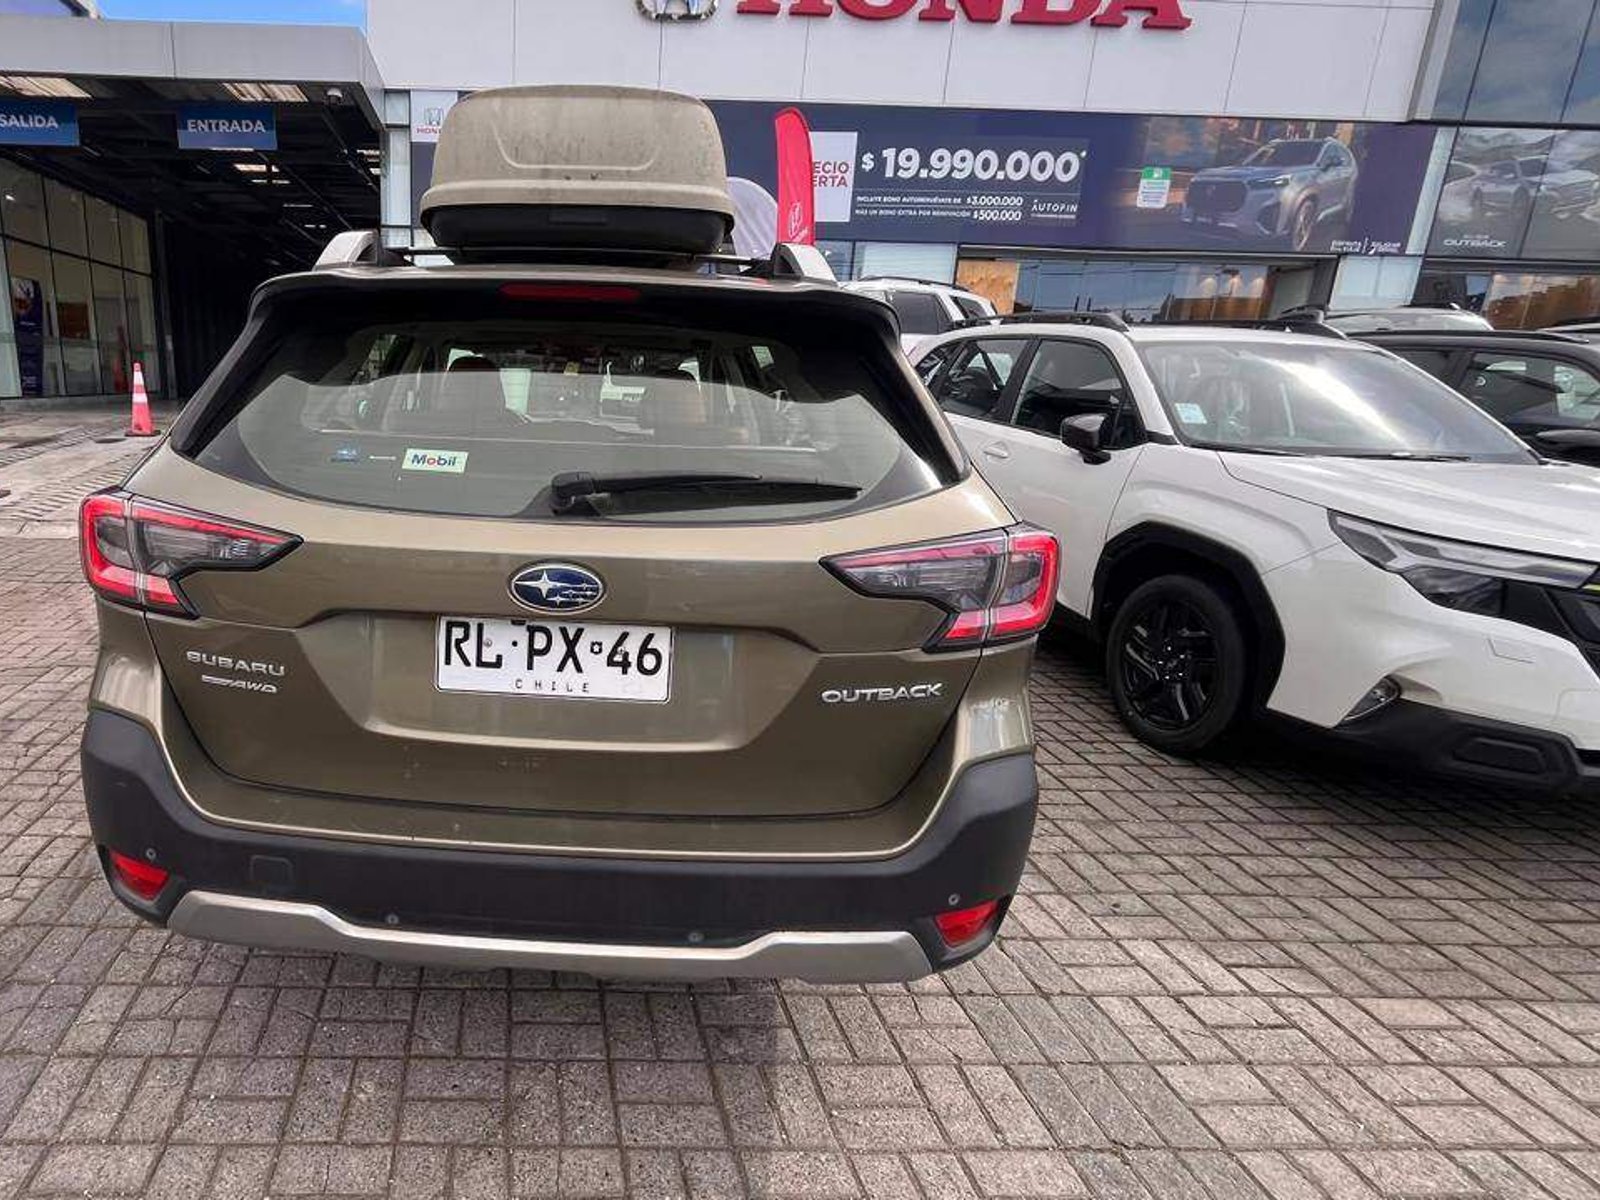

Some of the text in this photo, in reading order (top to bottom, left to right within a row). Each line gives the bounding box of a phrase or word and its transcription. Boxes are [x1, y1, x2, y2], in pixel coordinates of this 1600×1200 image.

[0, 112, 58, 129] SALIDA
[186, 119, 266, 133] ENTRADA
[813, 161, 850, 174] ECIO
[861, 152, 875, 171] $
[812, 175, 848, 187] ERTA
[973, 209, 1022, 220] $500.000
[411, 454, 457, 467] Mobil
[186, 650, 285, 677] SUBARU
[515, 678, 590, 693] CHILE
[820, 682, 943, 703] OUTBACK
